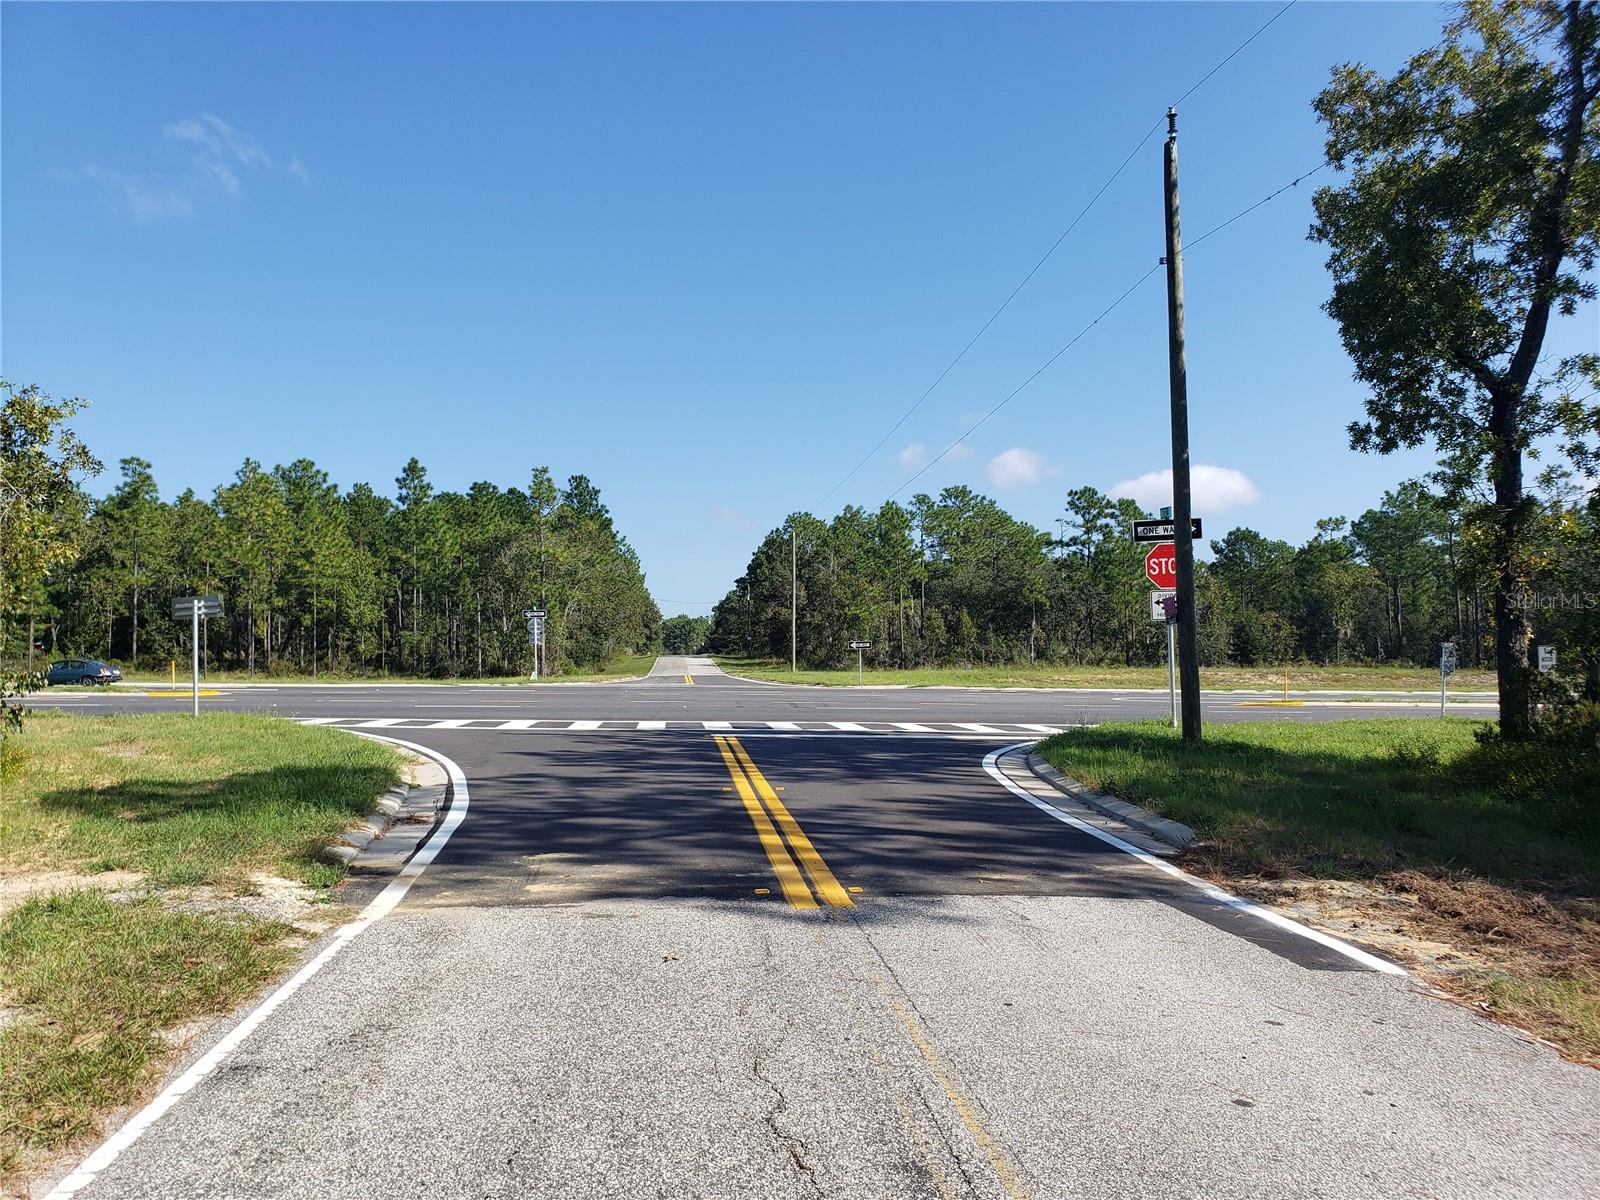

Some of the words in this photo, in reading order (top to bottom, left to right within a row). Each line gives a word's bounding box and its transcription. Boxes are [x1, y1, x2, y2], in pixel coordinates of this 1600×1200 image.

[1142, 526, 1159, 535] ONE
[1162, 525, 1175, 534] WA
[1149, 557, 1176, 575] STO
